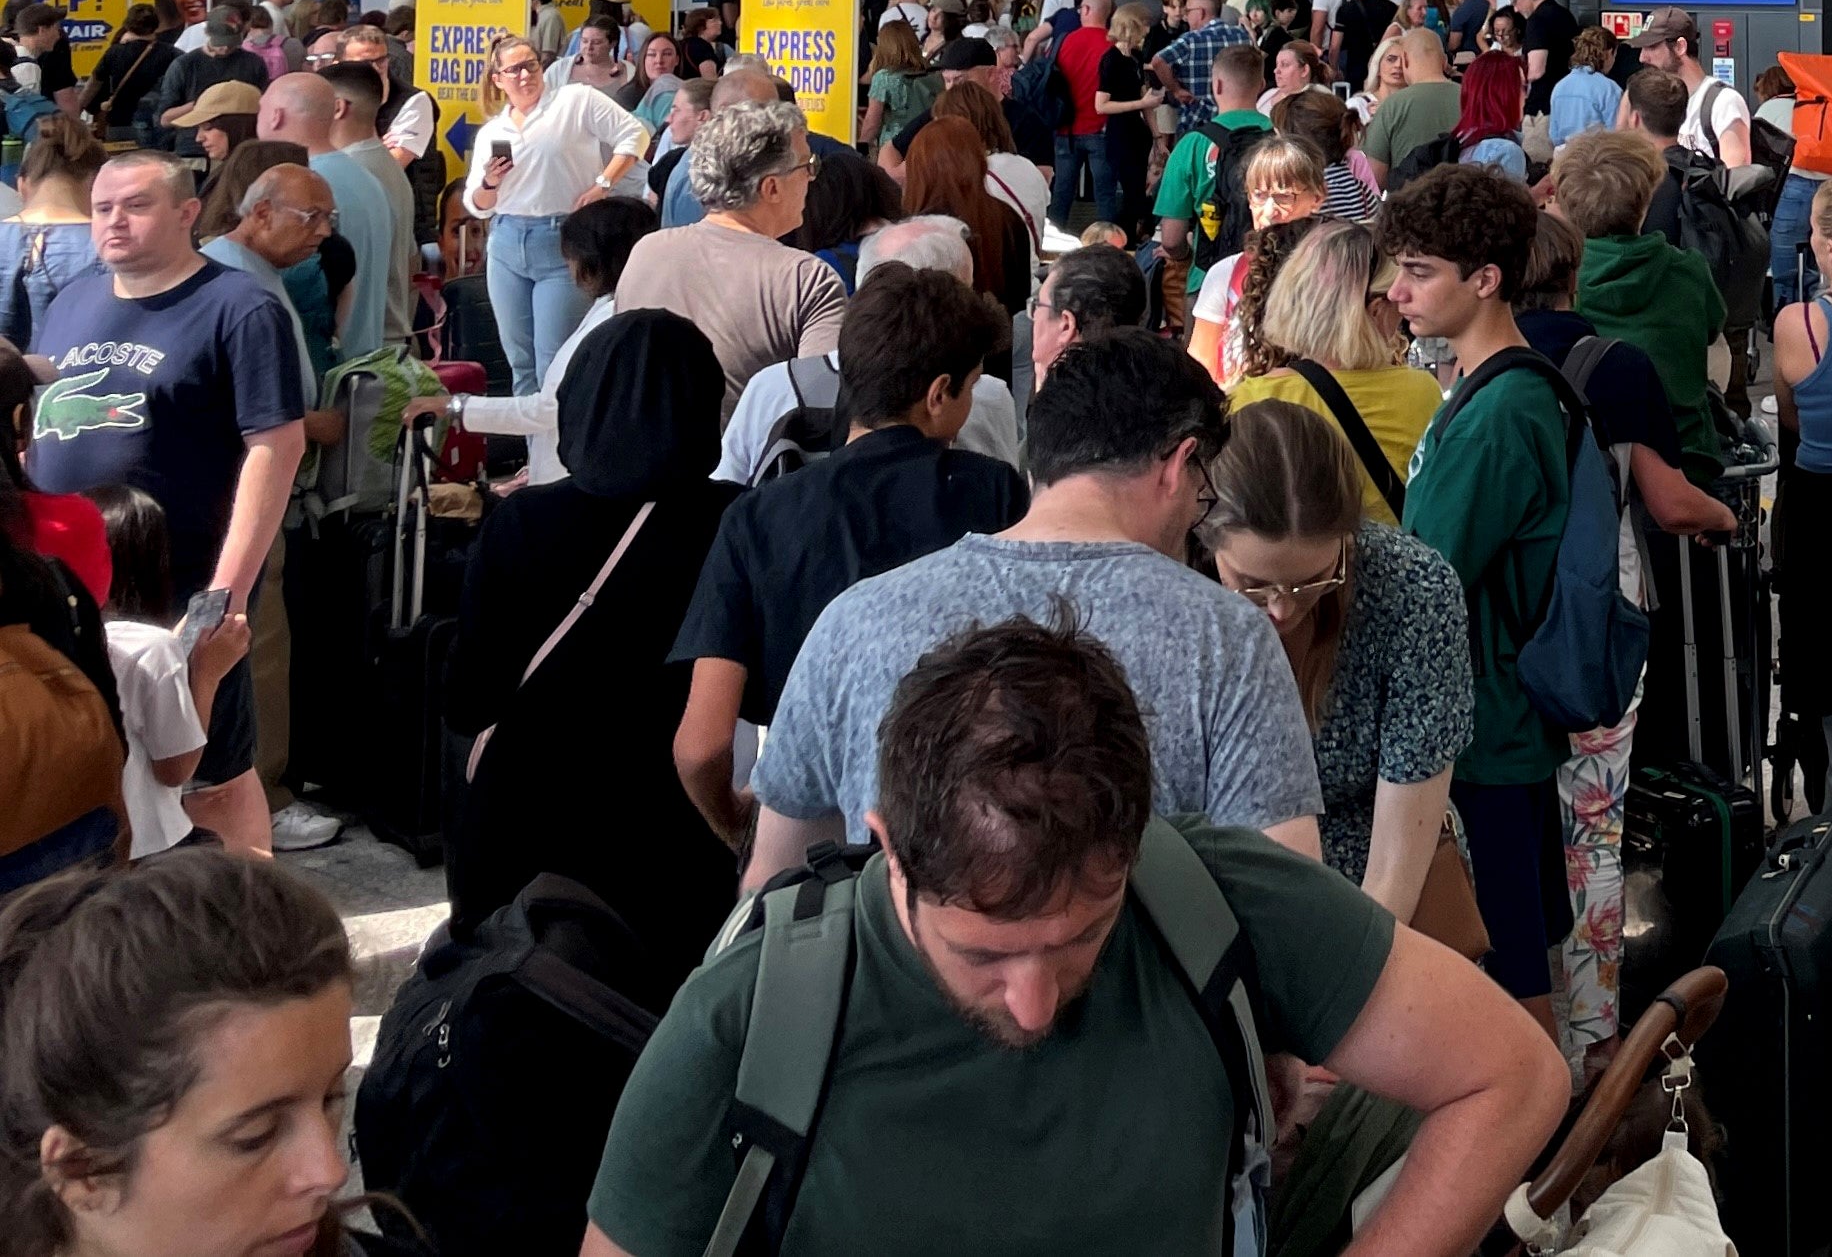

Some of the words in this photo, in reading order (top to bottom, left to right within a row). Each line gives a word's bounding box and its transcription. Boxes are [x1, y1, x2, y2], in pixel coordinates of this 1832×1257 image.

[431, 25, 509, 54] EXPRE
[756, 30, 835, 62] EXPRESS
[430, 58, 460, 83] BAG
[793, 66, 835, 94] DROP
[437, 88, 459, 100] BEAT
[460, 88, 473, 100] THE
[49, 341, 165, 374] ACOSTE
